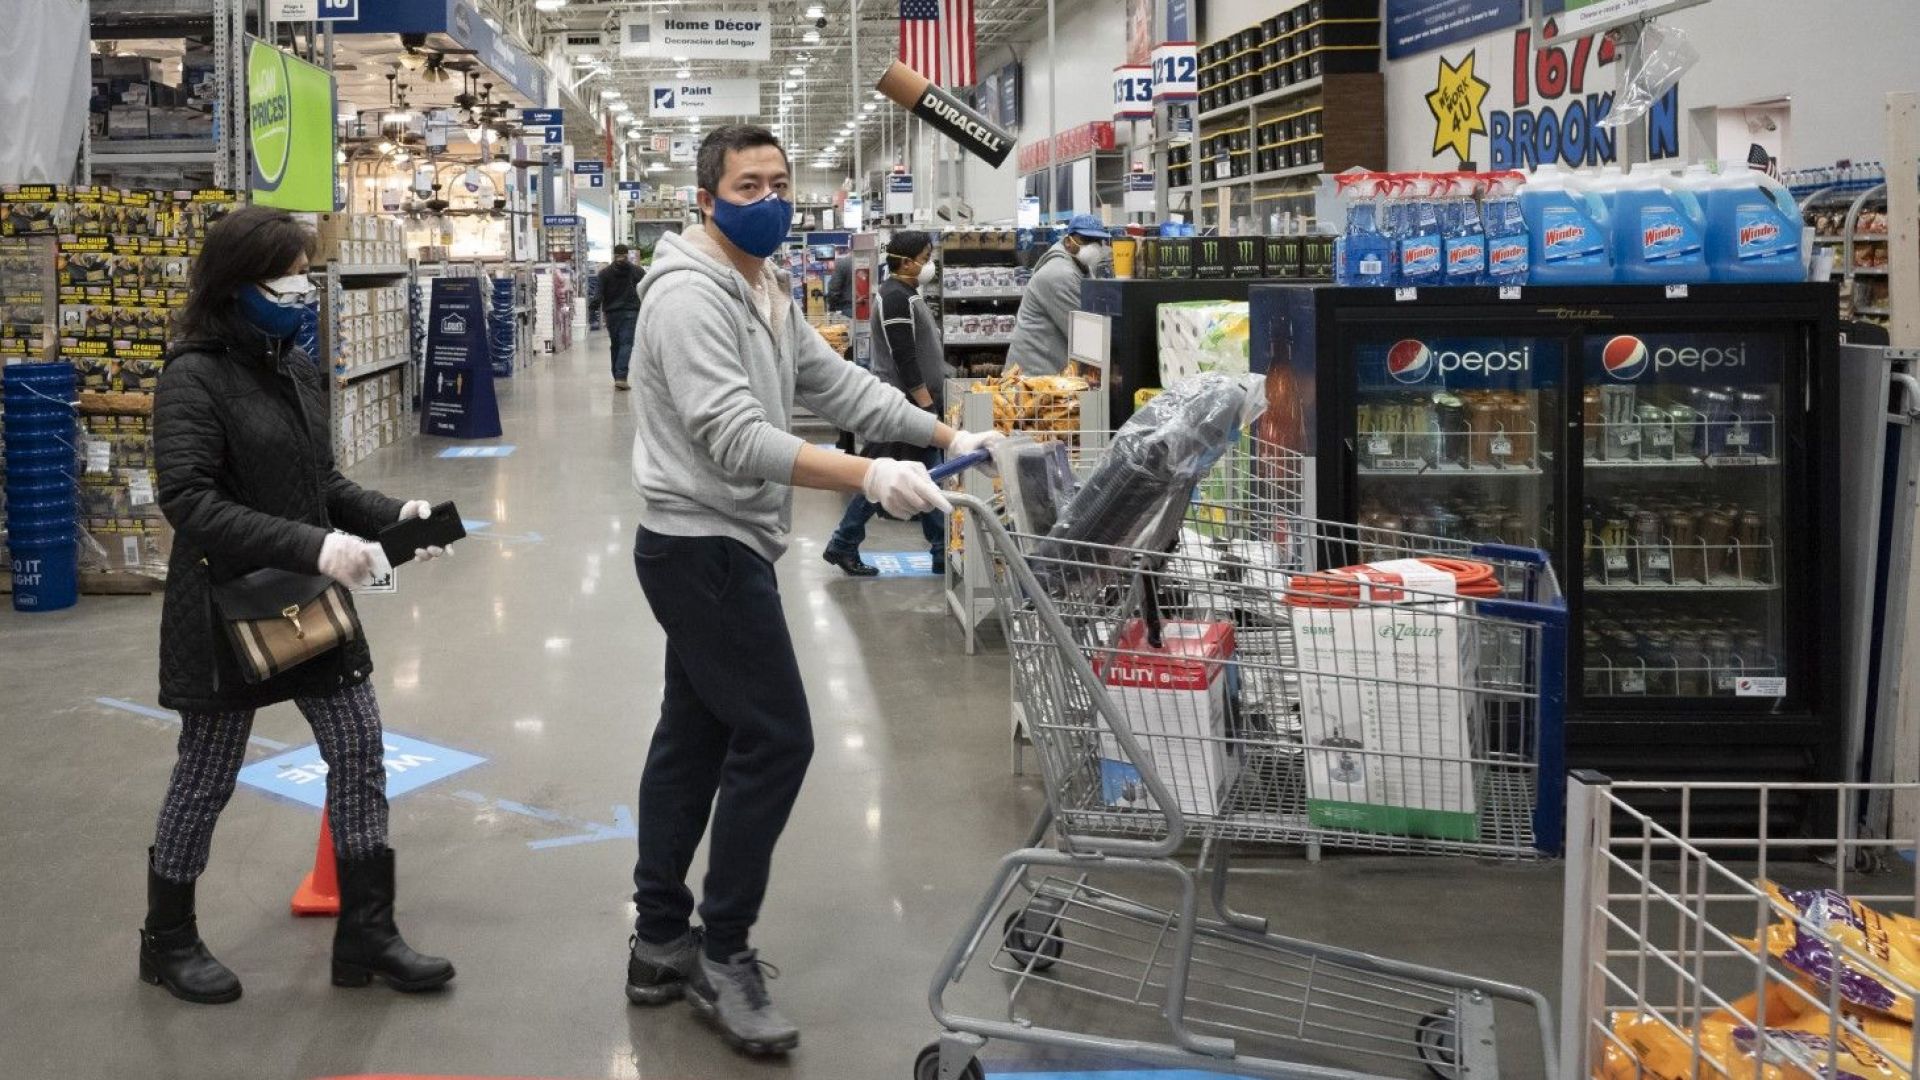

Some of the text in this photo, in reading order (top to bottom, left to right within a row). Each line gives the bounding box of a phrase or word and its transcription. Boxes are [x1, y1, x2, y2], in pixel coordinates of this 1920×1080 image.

[664, 18, 762, 31] Home Décor
[664, 36, 756, 48] Decoración del hogar
[1164, 56, 1196, 82] 12
[681, 86, 712, 96] Paint
[1123, 78, 1153, 102] 13
[251, 95, 287, 131] PRICES!
[921, 93, 1001, 153] DURACELL
[549, 131, 557, 140] 7
[1490, 82, 1680, 174] BROOKN
[1545, 225, 1585, 246] Windex
[1644, 224, 1684, 246] Windex
[1739, 223, 1780, 246] Windex
[1404, 245, 1439, 264] Windex
[1449, 246, 1481, 264] Windex
[1491, 247, 1526, 264] Windex
[1438, 345, 1530, 377] pepsi
[1655, 343, 1746, 373] pepsi
[26, 560, 41, 573] IT
[1302, 626, 1335, 636] SUMP
